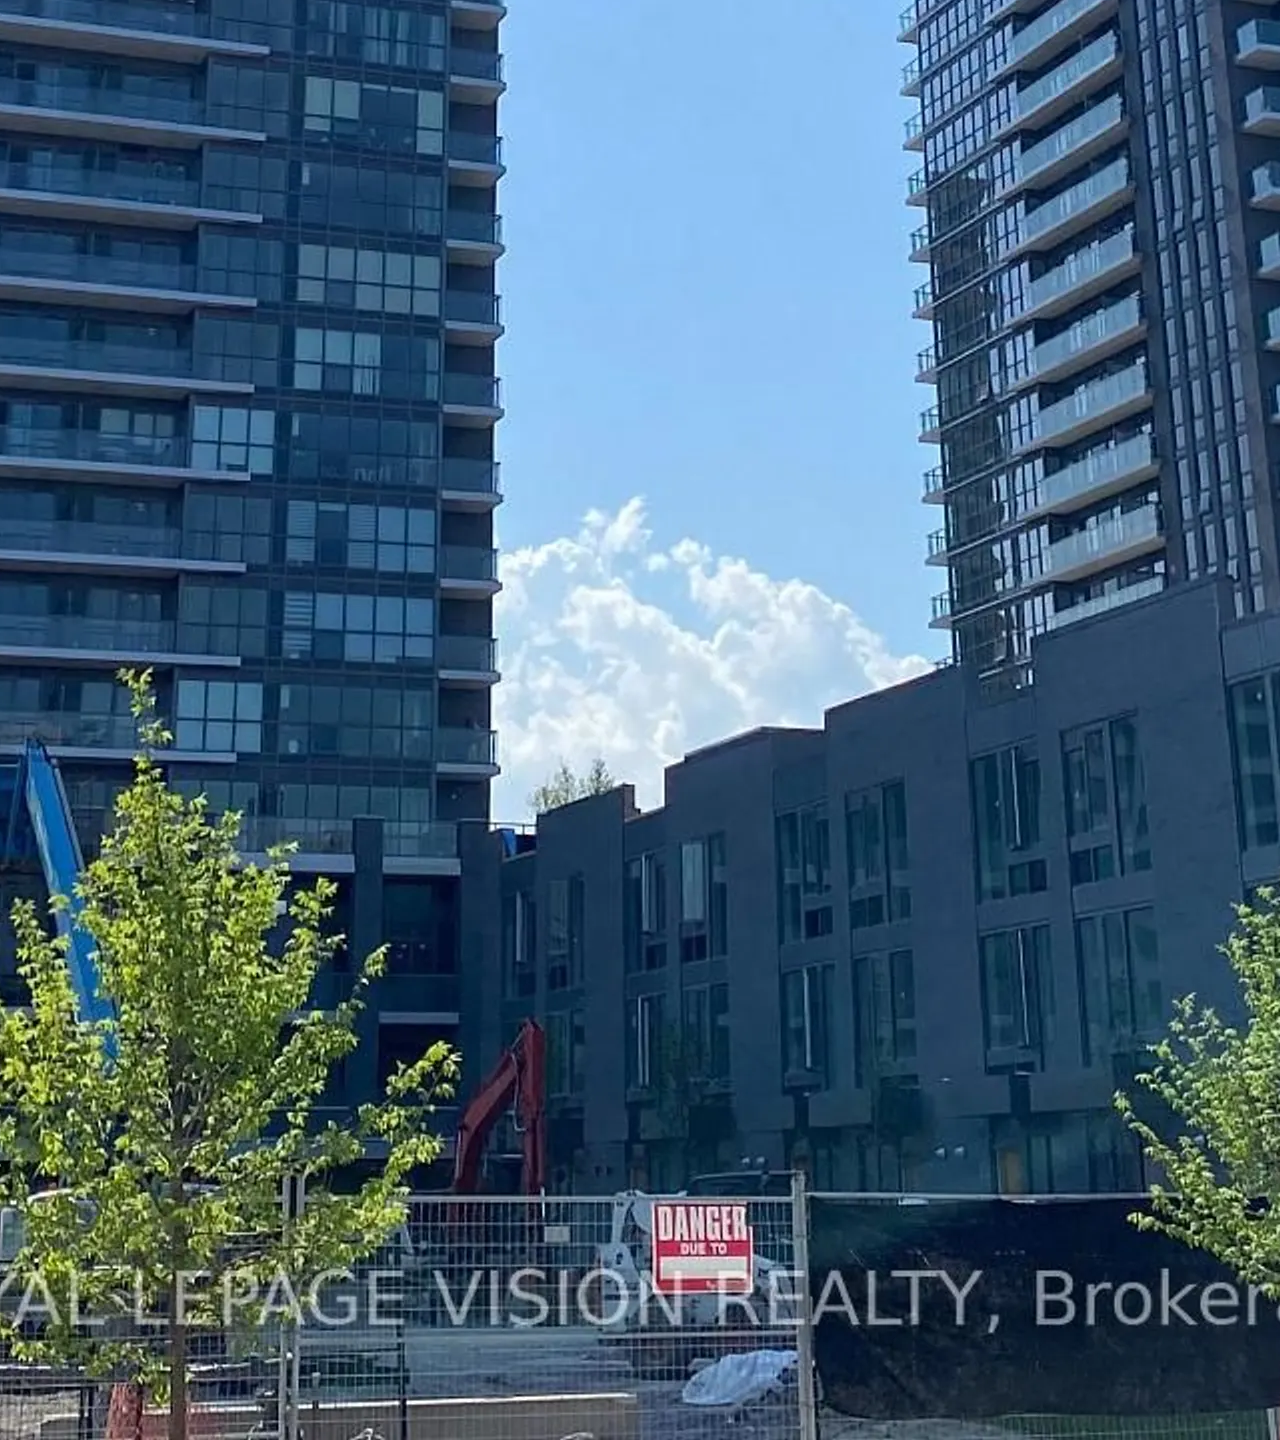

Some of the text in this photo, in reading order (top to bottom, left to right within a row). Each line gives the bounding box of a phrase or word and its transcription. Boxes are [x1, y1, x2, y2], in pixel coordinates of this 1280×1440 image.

[657, 1206, 748, 1241] DANGER
[680, 1242, 727, 1255] DUE TO
